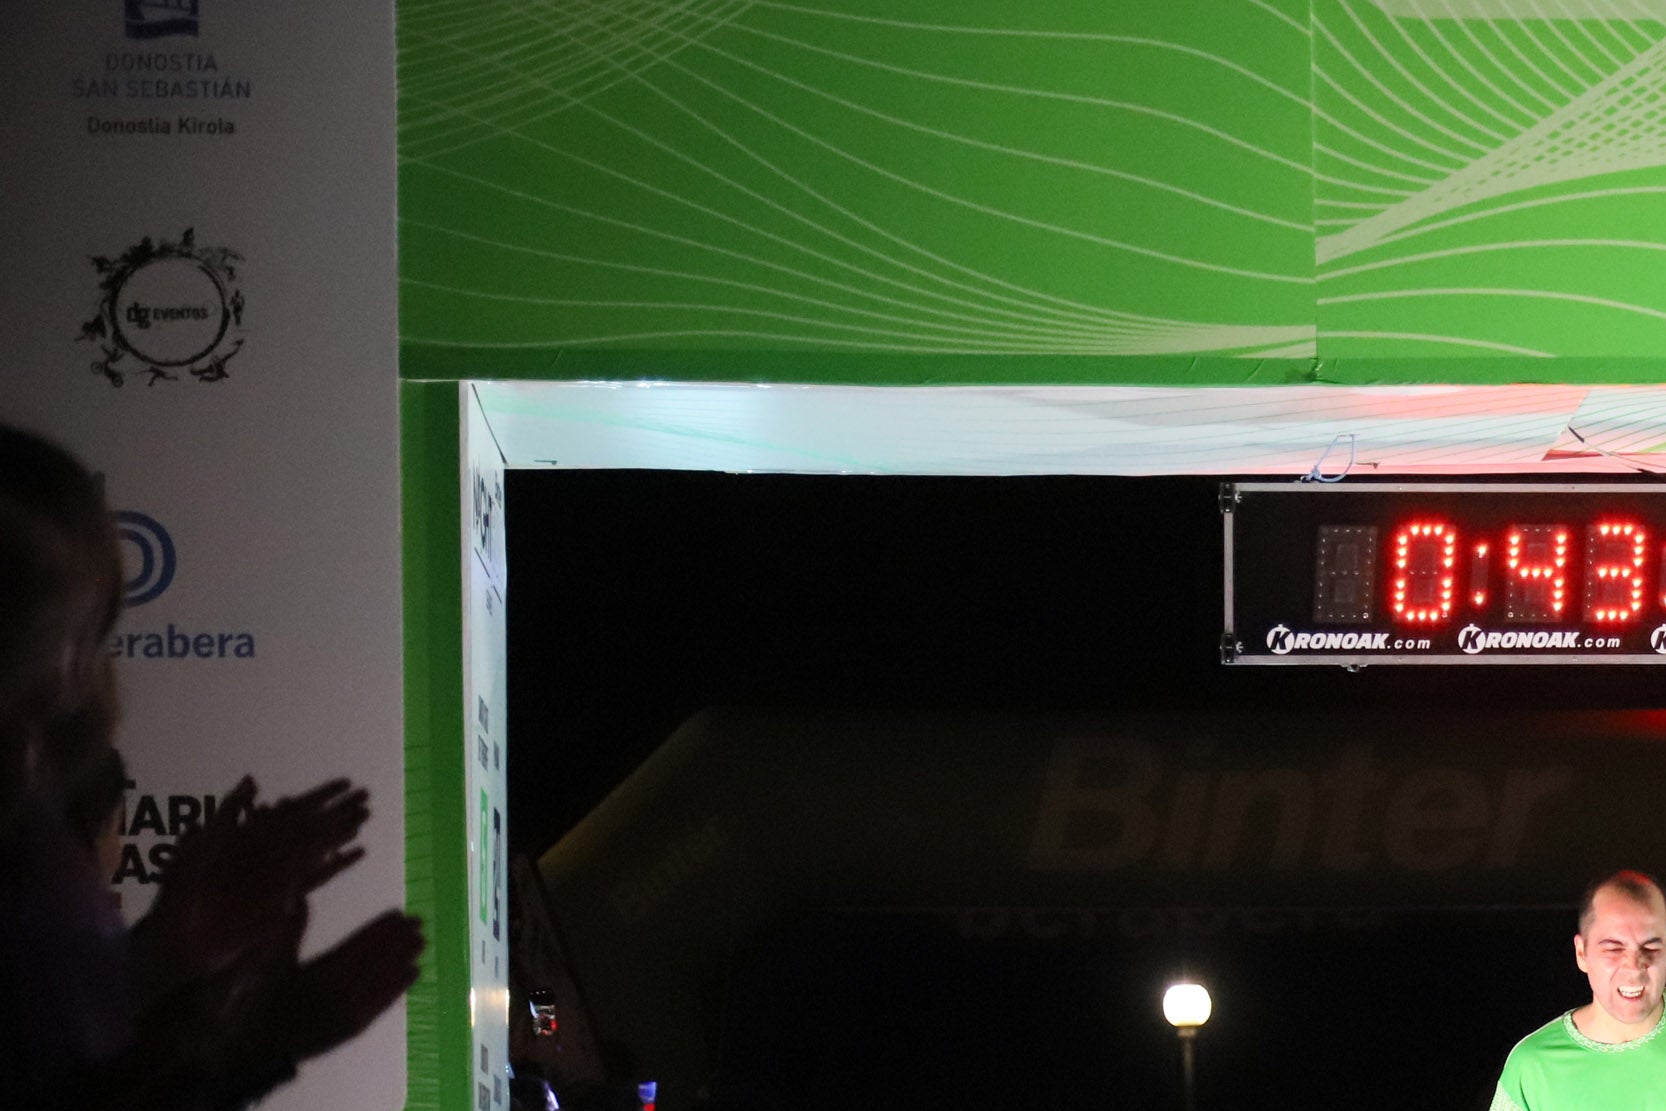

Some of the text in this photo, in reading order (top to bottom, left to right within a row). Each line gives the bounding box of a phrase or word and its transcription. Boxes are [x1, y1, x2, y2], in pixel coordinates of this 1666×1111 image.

[106, 54, 218, 72] DONOSTIA
[72, 76, 250, 98] SAN SEBASTIÁN
[88, 117, 235, 135] Donostia Kirola
[153, 307, 209, 321] EVENTOS
[1024, 735, 1574, 873] Binter
